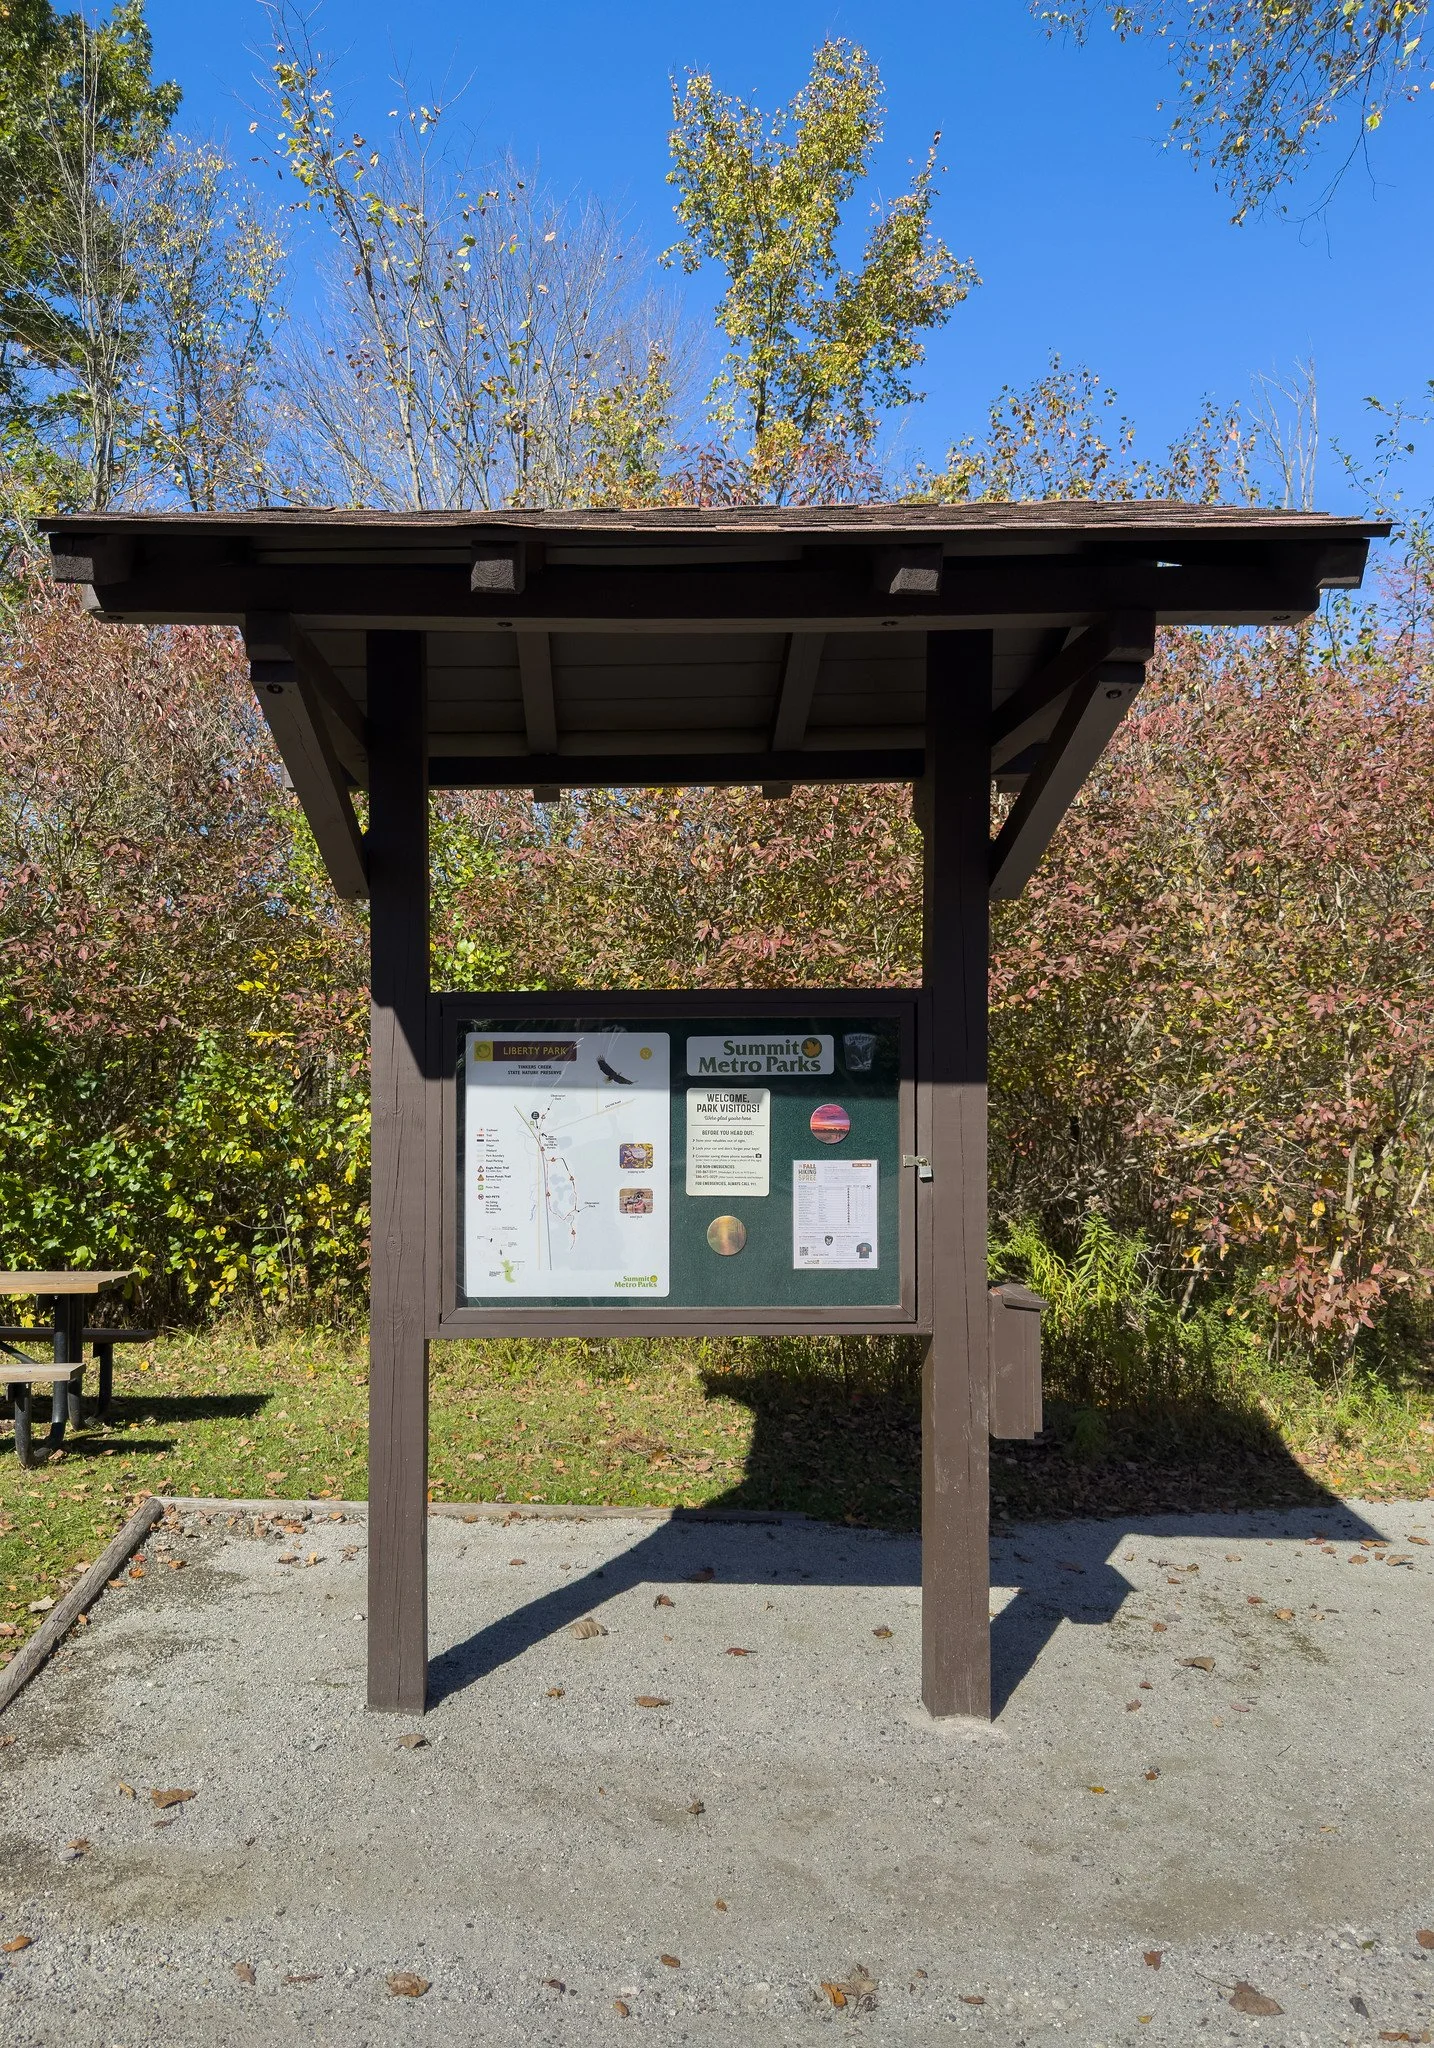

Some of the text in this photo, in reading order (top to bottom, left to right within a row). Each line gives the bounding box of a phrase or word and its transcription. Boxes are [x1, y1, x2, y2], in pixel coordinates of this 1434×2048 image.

[503, 1046, 567, 1055] LIBERTY PARK
[723, 1039, 800, 1056] Summit
[698, 1056, 821, 1073] Metro Parks
[706, 1093, 750, 1103] WELCOME,
[696, 1103, 760, 1113] PARK VISITORS!
